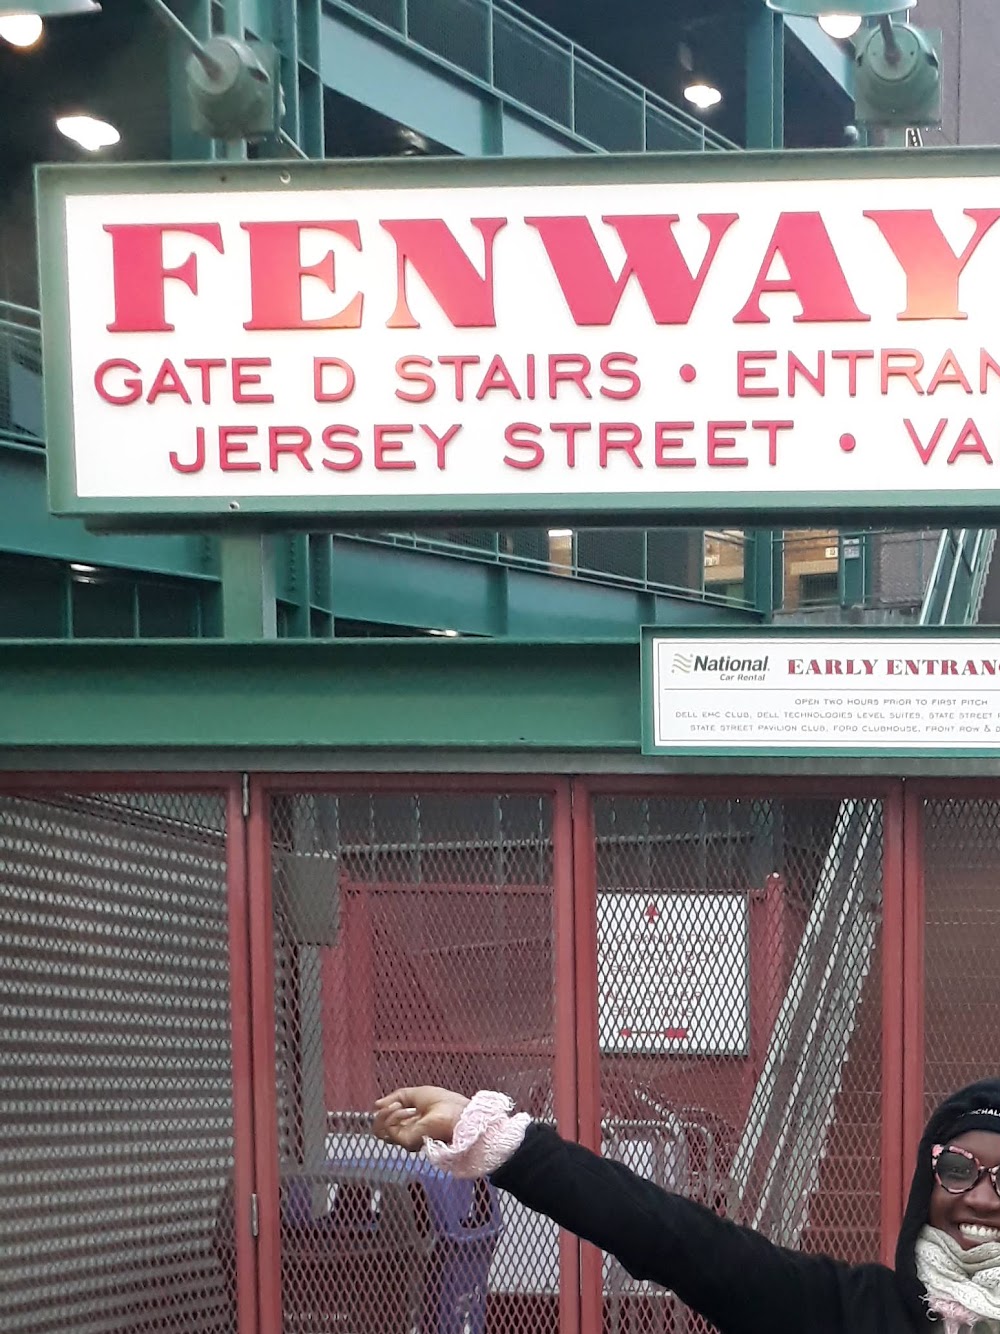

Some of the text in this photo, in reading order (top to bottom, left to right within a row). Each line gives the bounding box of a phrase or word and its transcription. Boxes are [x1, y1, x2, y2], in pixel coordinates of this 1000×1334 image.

[95, 357, 273, 405] GATE
[314, 358, 354, 403] D
[395, 353, 640, 403] STAIRS
[170, 424, 460, 473] JERSEY
[504, 421, 793, 470] STREET
[693, 655, 769, 672] National
[787, 659, 878, 676] EARLY
[720, 673, 766, 681] Car Rental
[795, 698, 820, 706] OPEN
[824, 698, 843, 706] TWO
[847, 698, 879, 706] HOURS
[883, 698, 912, 706] PRIOR
[915, 698, 928, 706] TO
[784, 711, 853, 719] TECHNOLOGIES
[757, 724, 797, 732] PAVILION
